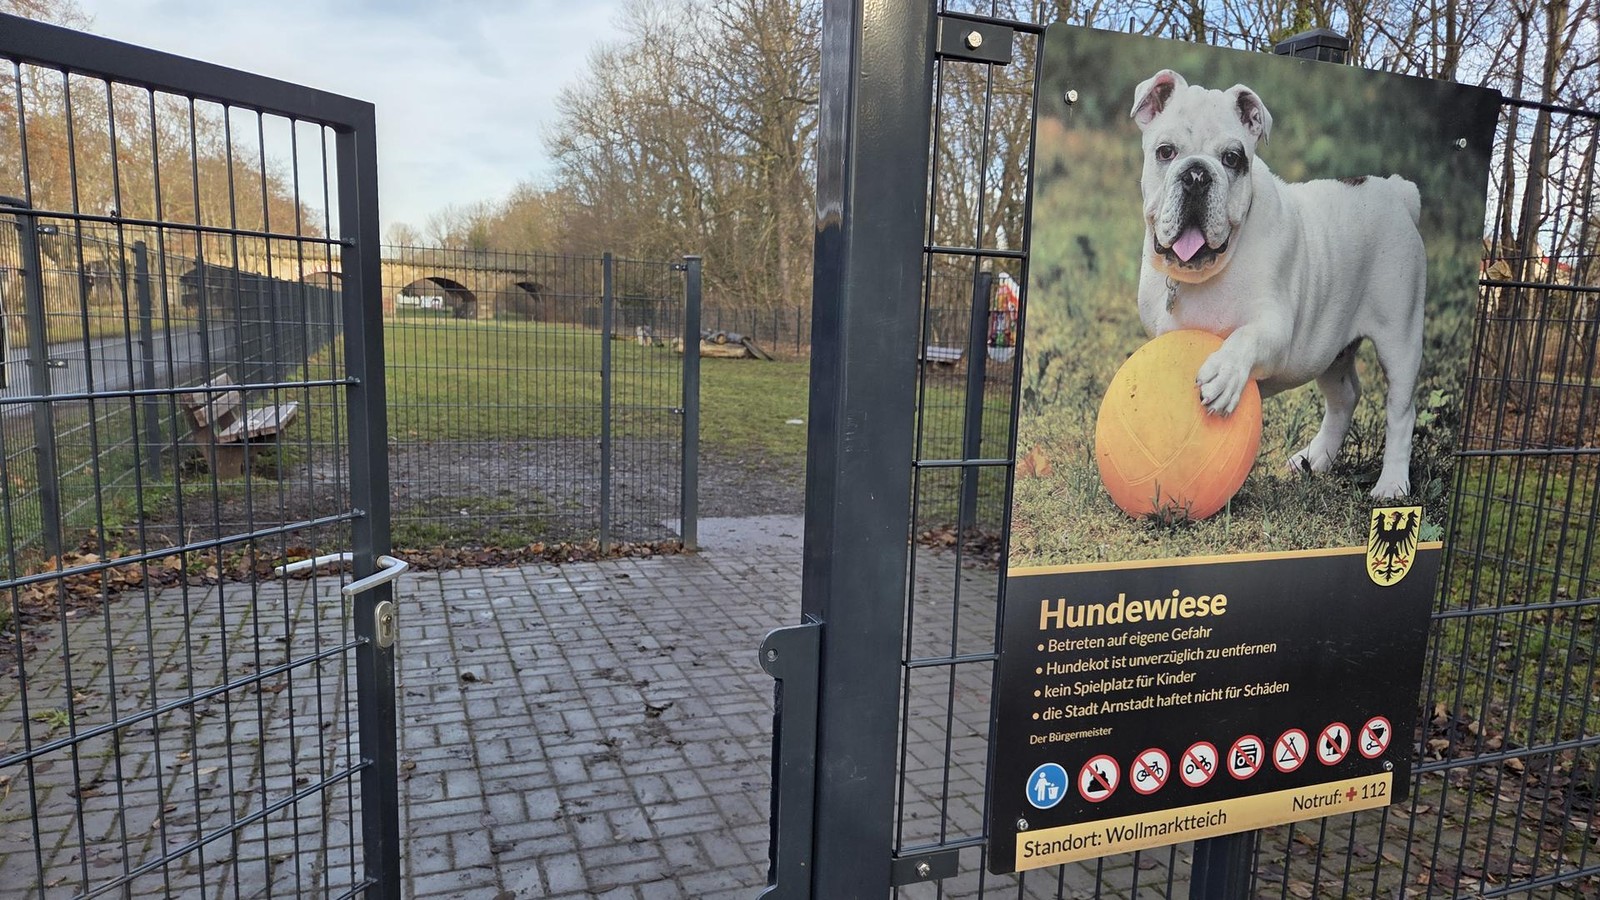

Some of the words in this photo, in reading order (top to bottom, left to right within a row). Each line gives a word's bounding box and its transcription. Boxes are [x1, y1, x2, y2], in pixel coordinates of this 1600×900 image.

[1040, 589, 1228, 630] Hundewiese
[1048, 638, 1105, 652] Betreten
[1107, 634, 1128, 648] auf
[1129, 630, 1169, 648] eigene
[1171, 626, 1213, 641] Gefahr
[1046, 659, 1109, 675] Hundekot
[1111, 656, 1127, 669] ist
[1129, 650, 1204, 667] unverzüglich
[1206, 649, 1220, 659] zu
[1222, 642, 1277, 657] entfernen
[1044, 684, 1072, 698] kein
[1074, 678, 1134, 697] Spielplatz
[1136, 676, 1155, 691] für
[1156, 671, 1197, 686] Kinder
[1042, 707, 1063, 721] die
[1065, 703, 1099, 719] Stadt
[1101, 698, 1155, 715] Arnstadt
[1156, 694, 1193, 708] haftet
[1194, 690, 1223, 703] nicht
[1225, 686, 1242, 700] für
[1244, 681, 1290, 697] Schäden
[1029, 734, 1048, 745] Der
[1049, 726, 1113, 743] Bürgermeister
[1292, 790, 1342, 812] Notruf:
[1361, 782, 1386, 800] 112
[1023, 832, 1102, 858] Standort:
[1105, 809, 1228, 844] Wollmarktteich
